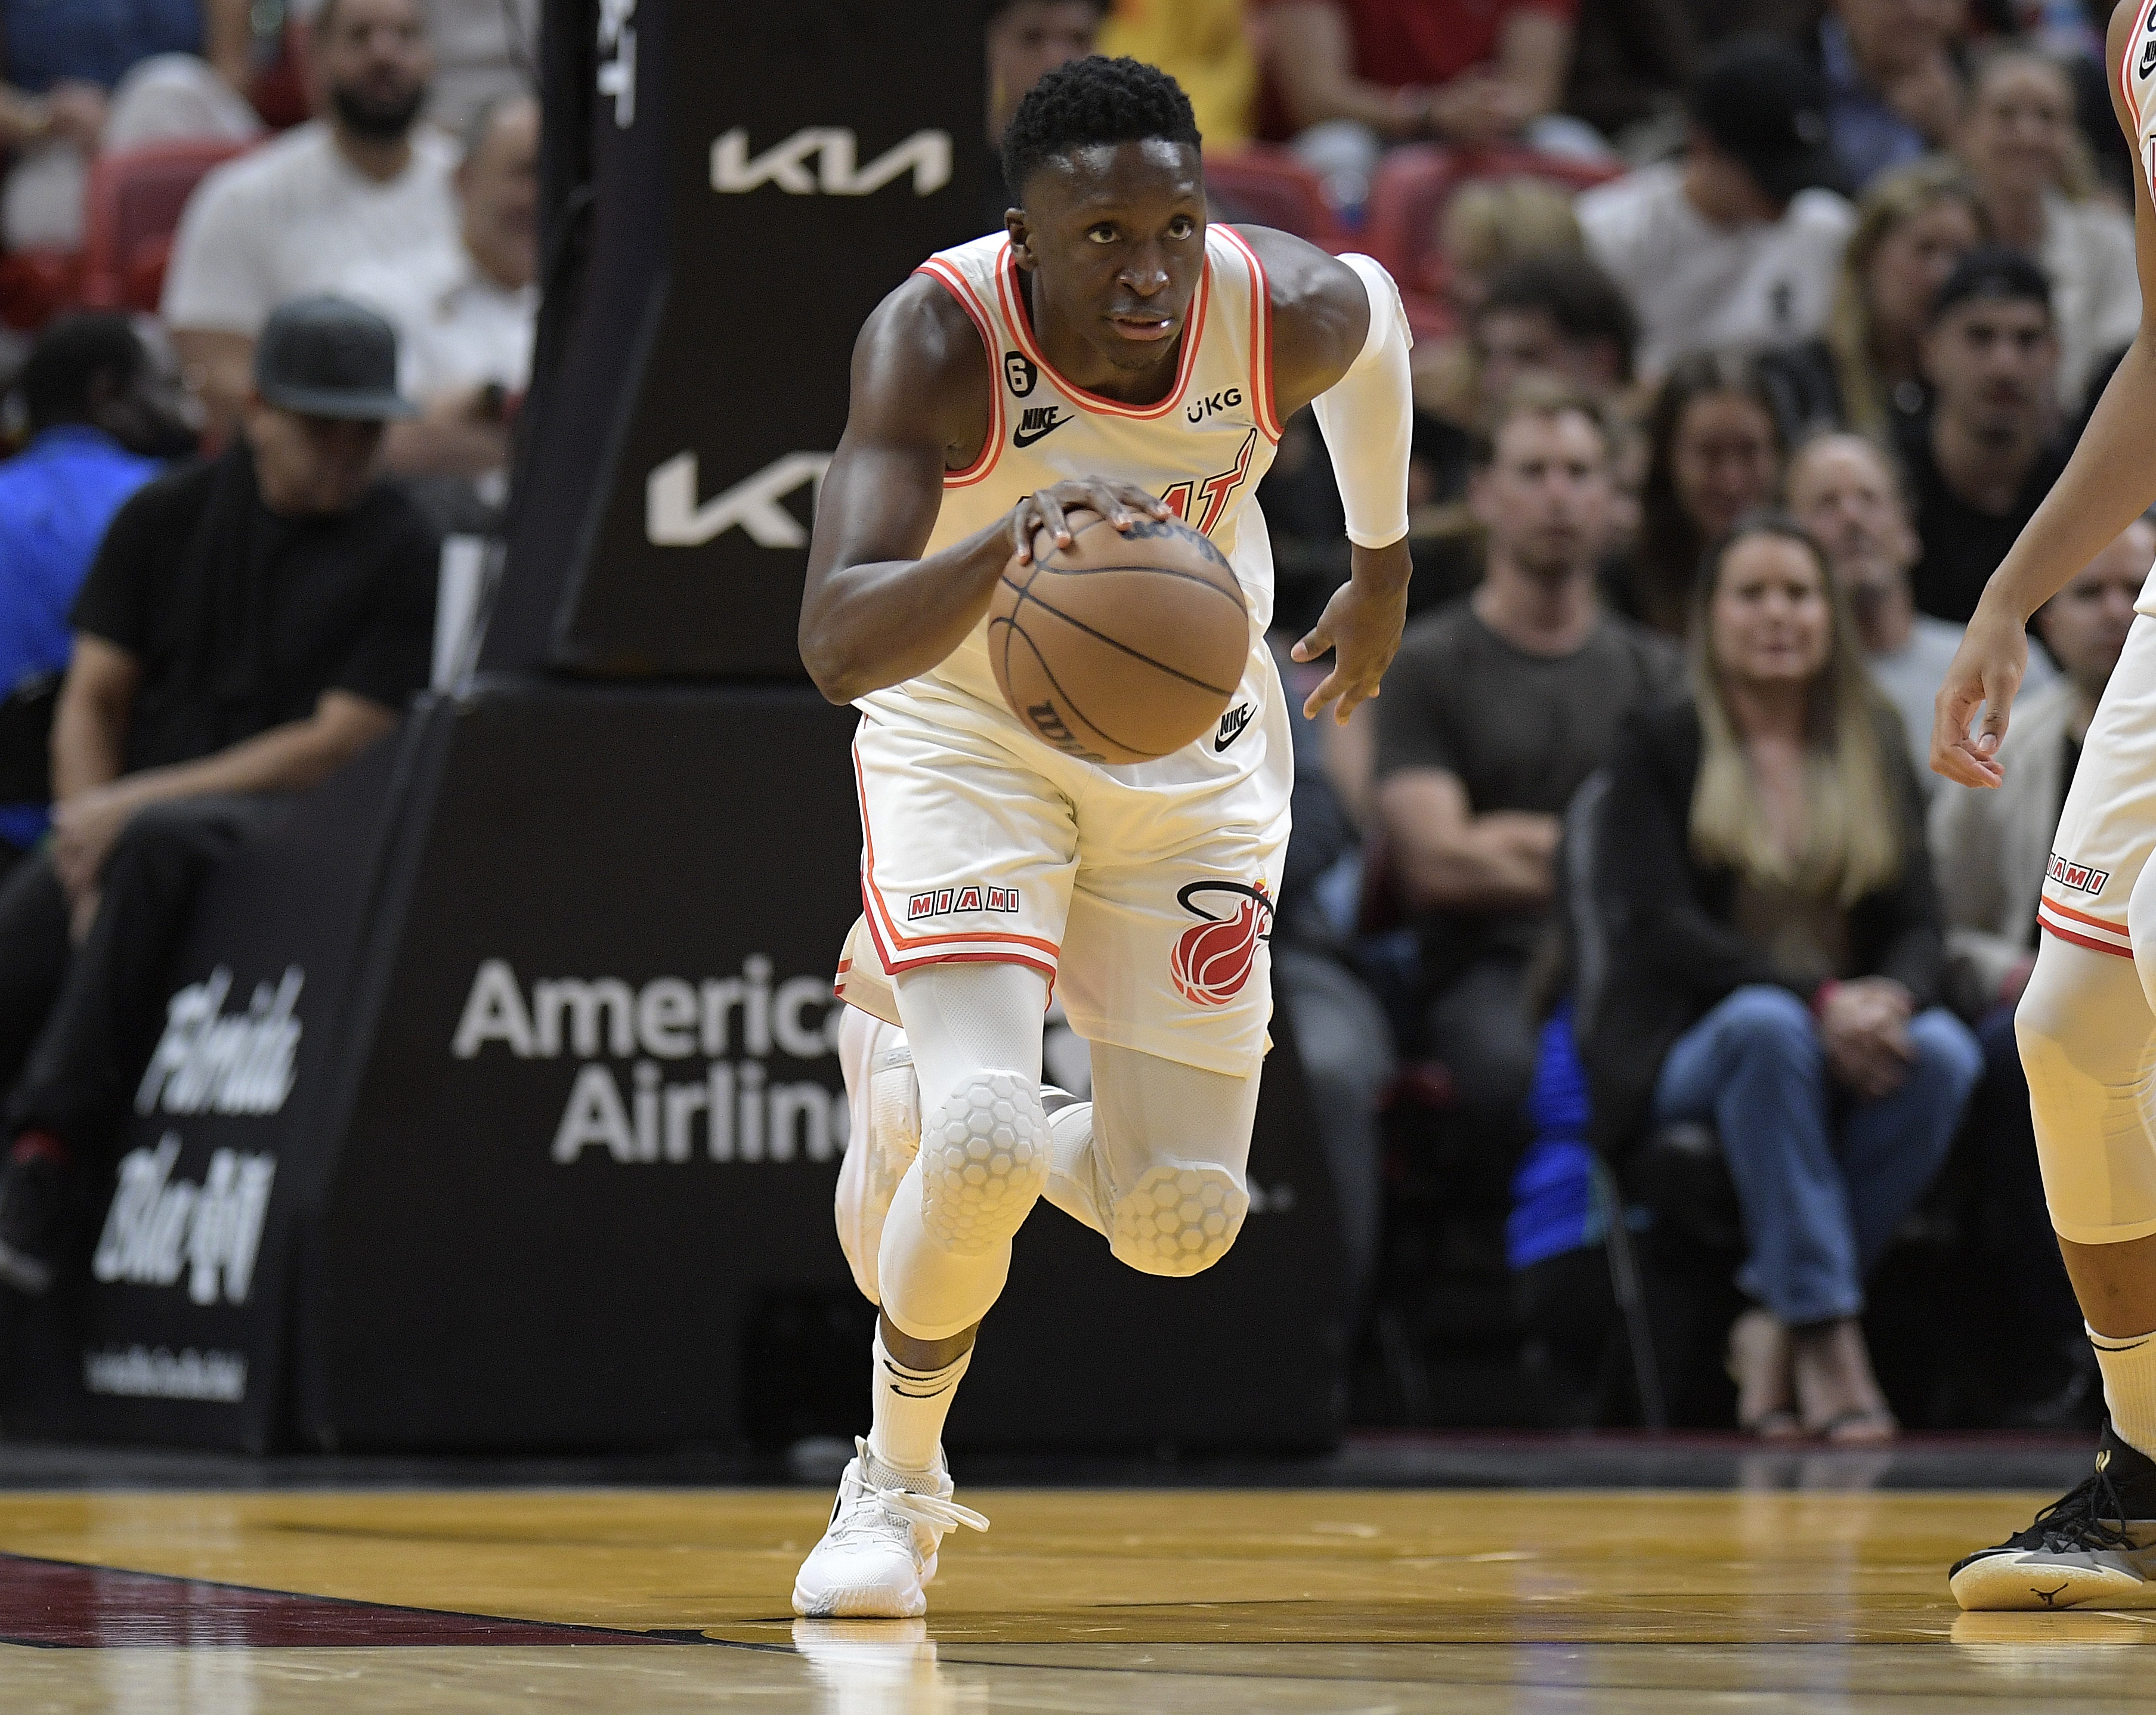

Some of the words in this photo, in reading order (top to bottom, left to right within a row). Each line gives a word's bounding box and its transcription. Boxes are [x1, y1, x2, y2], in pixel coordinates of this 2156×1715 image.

[710, 126, 952, 196] KIA
[1007, 358, 1029, 392] 6
[1021, 406, 1059, 431] NIKE
[1220, 702, 1248, 737] NIKE
[907, 886, 1019, 921] MIAMI
[451, 955, 841, 1060] Americ
[550, 1060, 849, 1165] Airlin
